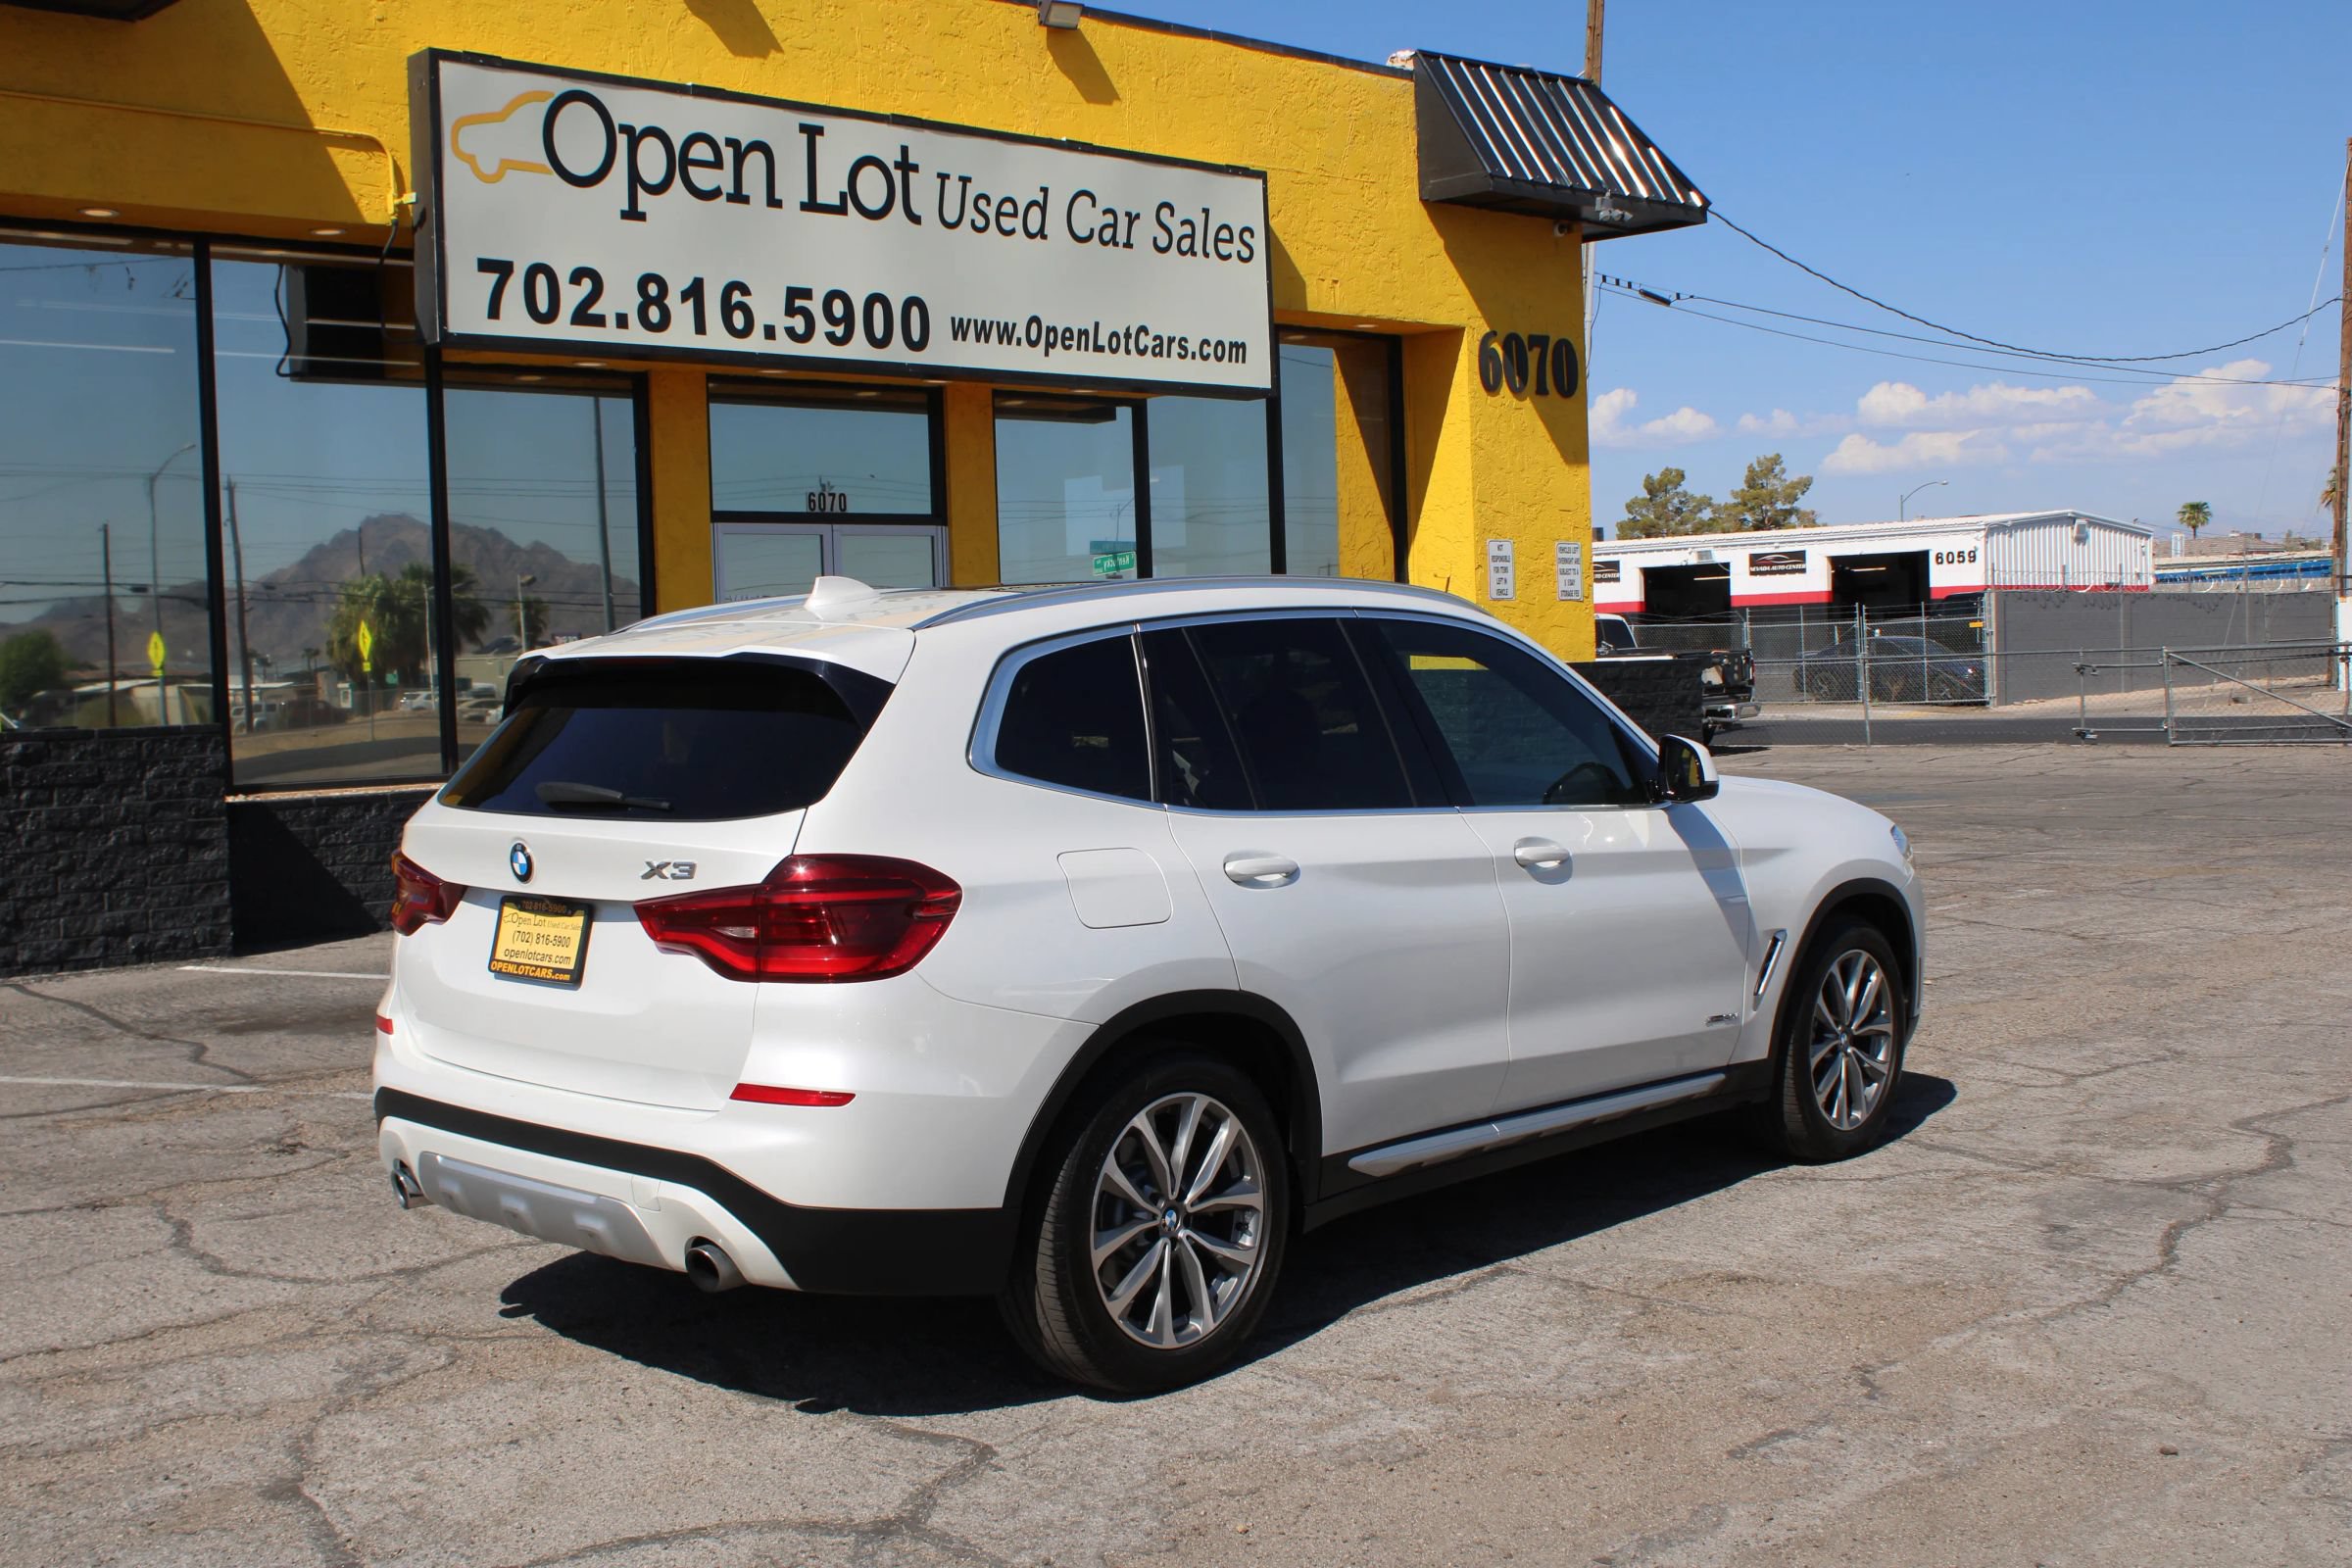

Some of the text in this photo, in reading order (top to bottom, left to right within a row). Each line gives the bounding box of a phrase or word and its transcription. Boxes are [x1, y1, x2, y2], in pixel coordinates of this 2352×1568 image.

[543, 89, 1255, 264] Open Lot Used Car Sales
[476, 257, 1249, 365] 702.816.5900 www.OpenLotCars.com
[1478, 330, 1579, 399] 6070
[808, 492, 848, 513] 6070
[1935, 550, 1978, 565] 6059
[640, 860, 698, 881] X3
[511, 912, 532, 928] Open
[533, 914, 547, 927] Lot
[512, 930, 571, 949] (702) 816-5900
[503, 948, 571, 965] openlotcars.com
[490, 960, 571, 981] OPENLOTCARS.com
